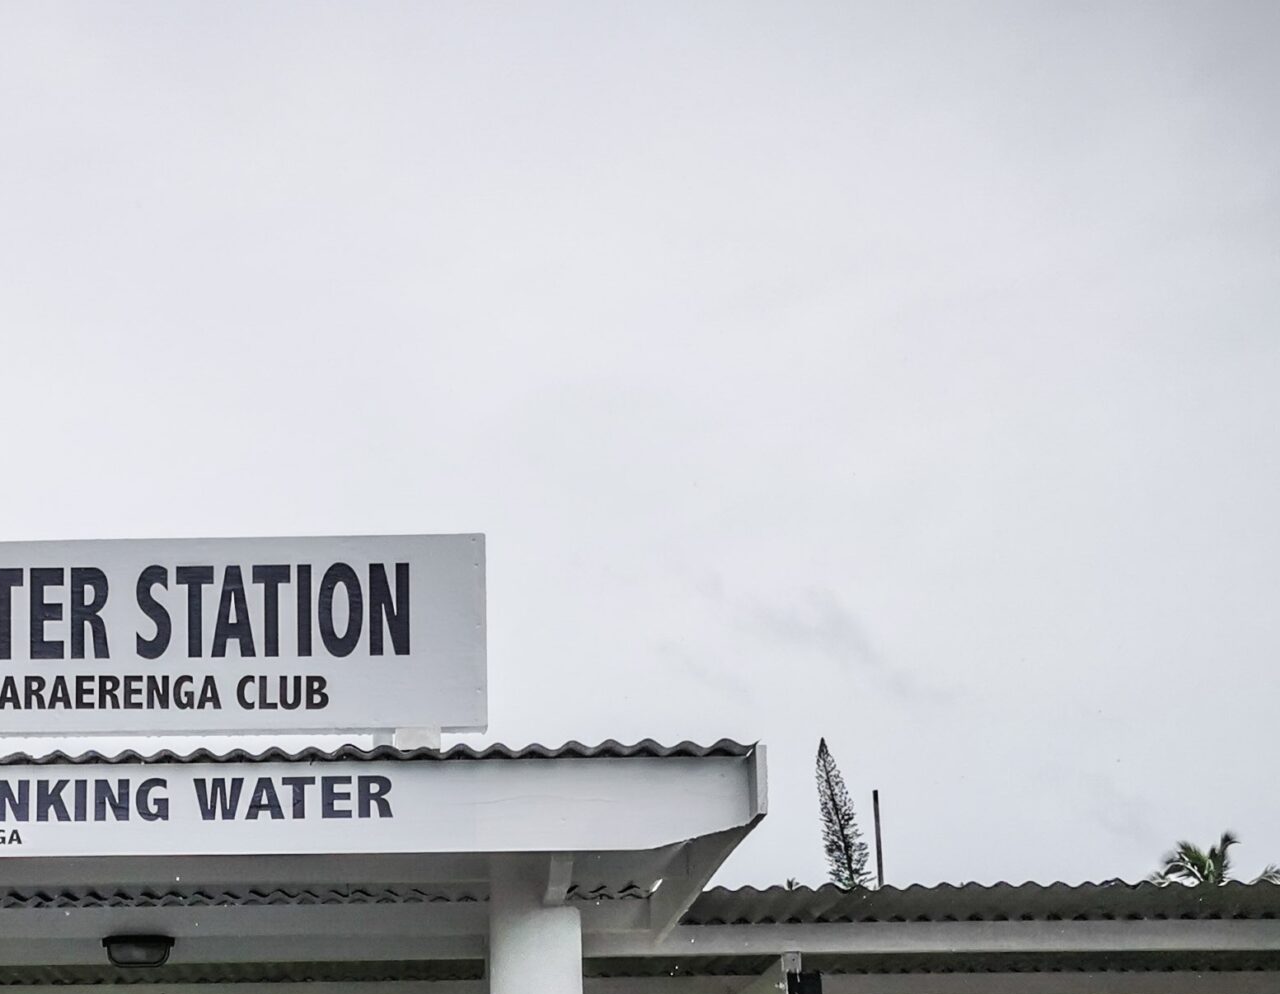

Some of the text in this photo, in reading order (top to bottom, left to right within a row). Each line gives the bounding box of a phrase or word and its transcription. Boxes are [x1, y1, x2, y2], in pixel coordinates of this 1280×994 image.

[135, 562, 411, 658] STATION
[236, 675, 329, 710] CLUB
[193, 775, 393, 820] WATER
